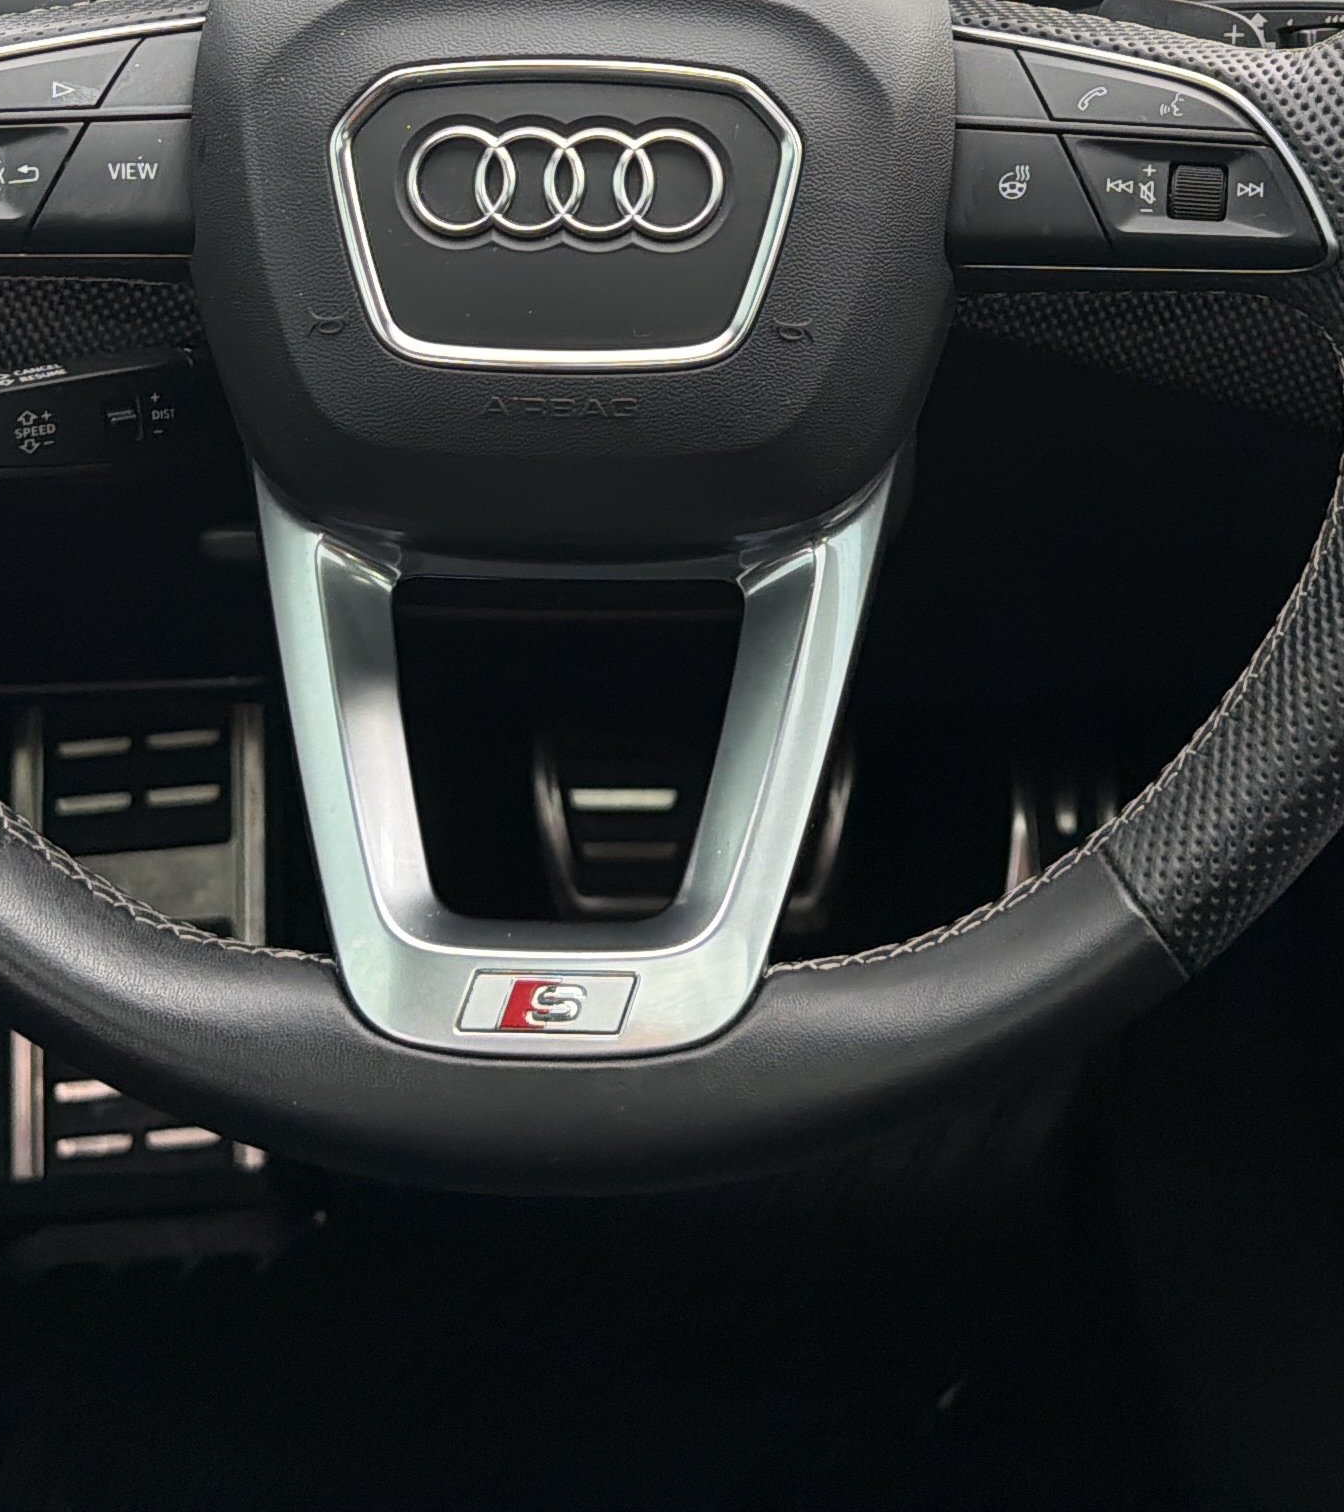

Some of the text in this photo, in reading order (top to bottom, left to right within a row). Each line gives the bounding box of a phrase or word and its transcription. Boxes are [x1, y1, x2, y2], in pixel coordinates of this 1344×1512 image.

[108, 162, 158, 180] VIEW
[13, 363, 63, 376] CANCEL
[19, 368, 69, 383] RESUME
[151, 408, 176, 421] DIST
[14, 422, 57, 440] SPEED
